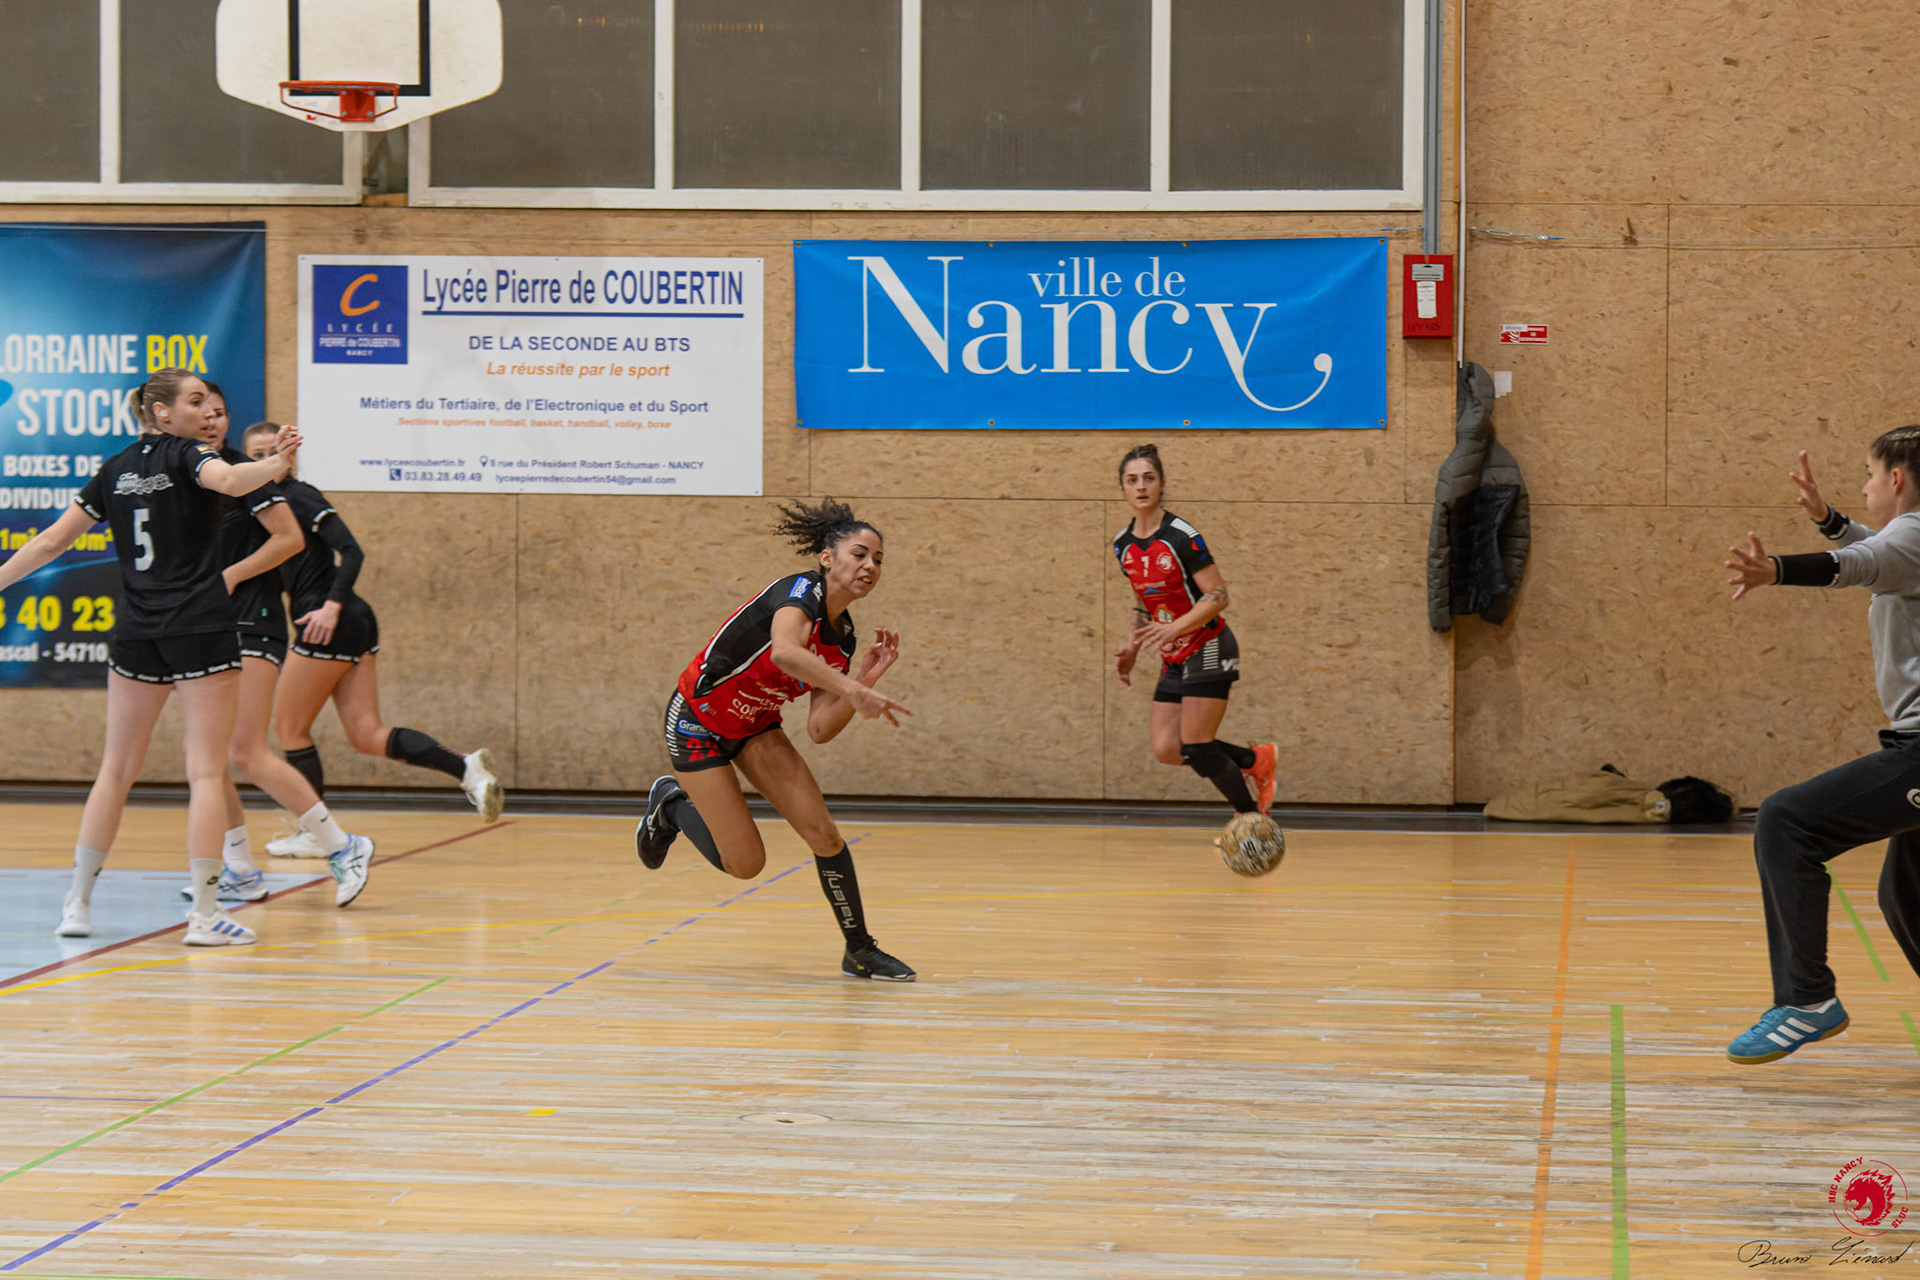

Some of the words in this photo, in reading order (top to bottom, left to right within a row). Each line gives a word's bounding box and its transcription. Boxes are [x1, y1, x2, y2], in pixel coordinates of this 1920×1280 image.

[423, 268, 488, 312] Lycée
[496, 269, 562, 304] Pierre
[569, 269, 596, 304] de
[603, 269, 743, 305] COUBERTIN
[1028, 256, 1123, 297] ville
[1134, 256, 1187, 297] de
[469, 335, 493, 350] DE
[499, 336, 523, 350] LA
[528, 336, 618, 351] SECONDE
[622, 336, 649, 351] AU
[655, 337, 691, 352] BTS
[847, 256, 1334, 412] Nancy
[0, 334, 139, 374] ORRAINE
[146, 334, 209, 374] BOX
[487, 361, 506, 375] La
[510, 361, 575, 376] réussite
[578, 365, 606, 379] par
[609, 363, 623, 377] le
[627, 363, 671, 379] sport
[17, 388, 143, 436] STOCK
[360, 397, 412, 410] Métiers
[415, 398, 434, 410] du
[438, 398, 500, 412] Tertiaire,
[504, 399, 522, 411] de
[629, 400, 643, 412] et
[646, 400, 665, 413] du
[669, 400, 709, 415] Sport
[4, 455, 71, 477] BOXES
[668, 461, 705, 470] NANCY
[134, 508, 156, 572] 5
[17, 595, 63, 632] 40
[72, 595, 116, 632] 23
[53, 642, 109, 662] 54710
[822, 869, 858, 929] kalenji
